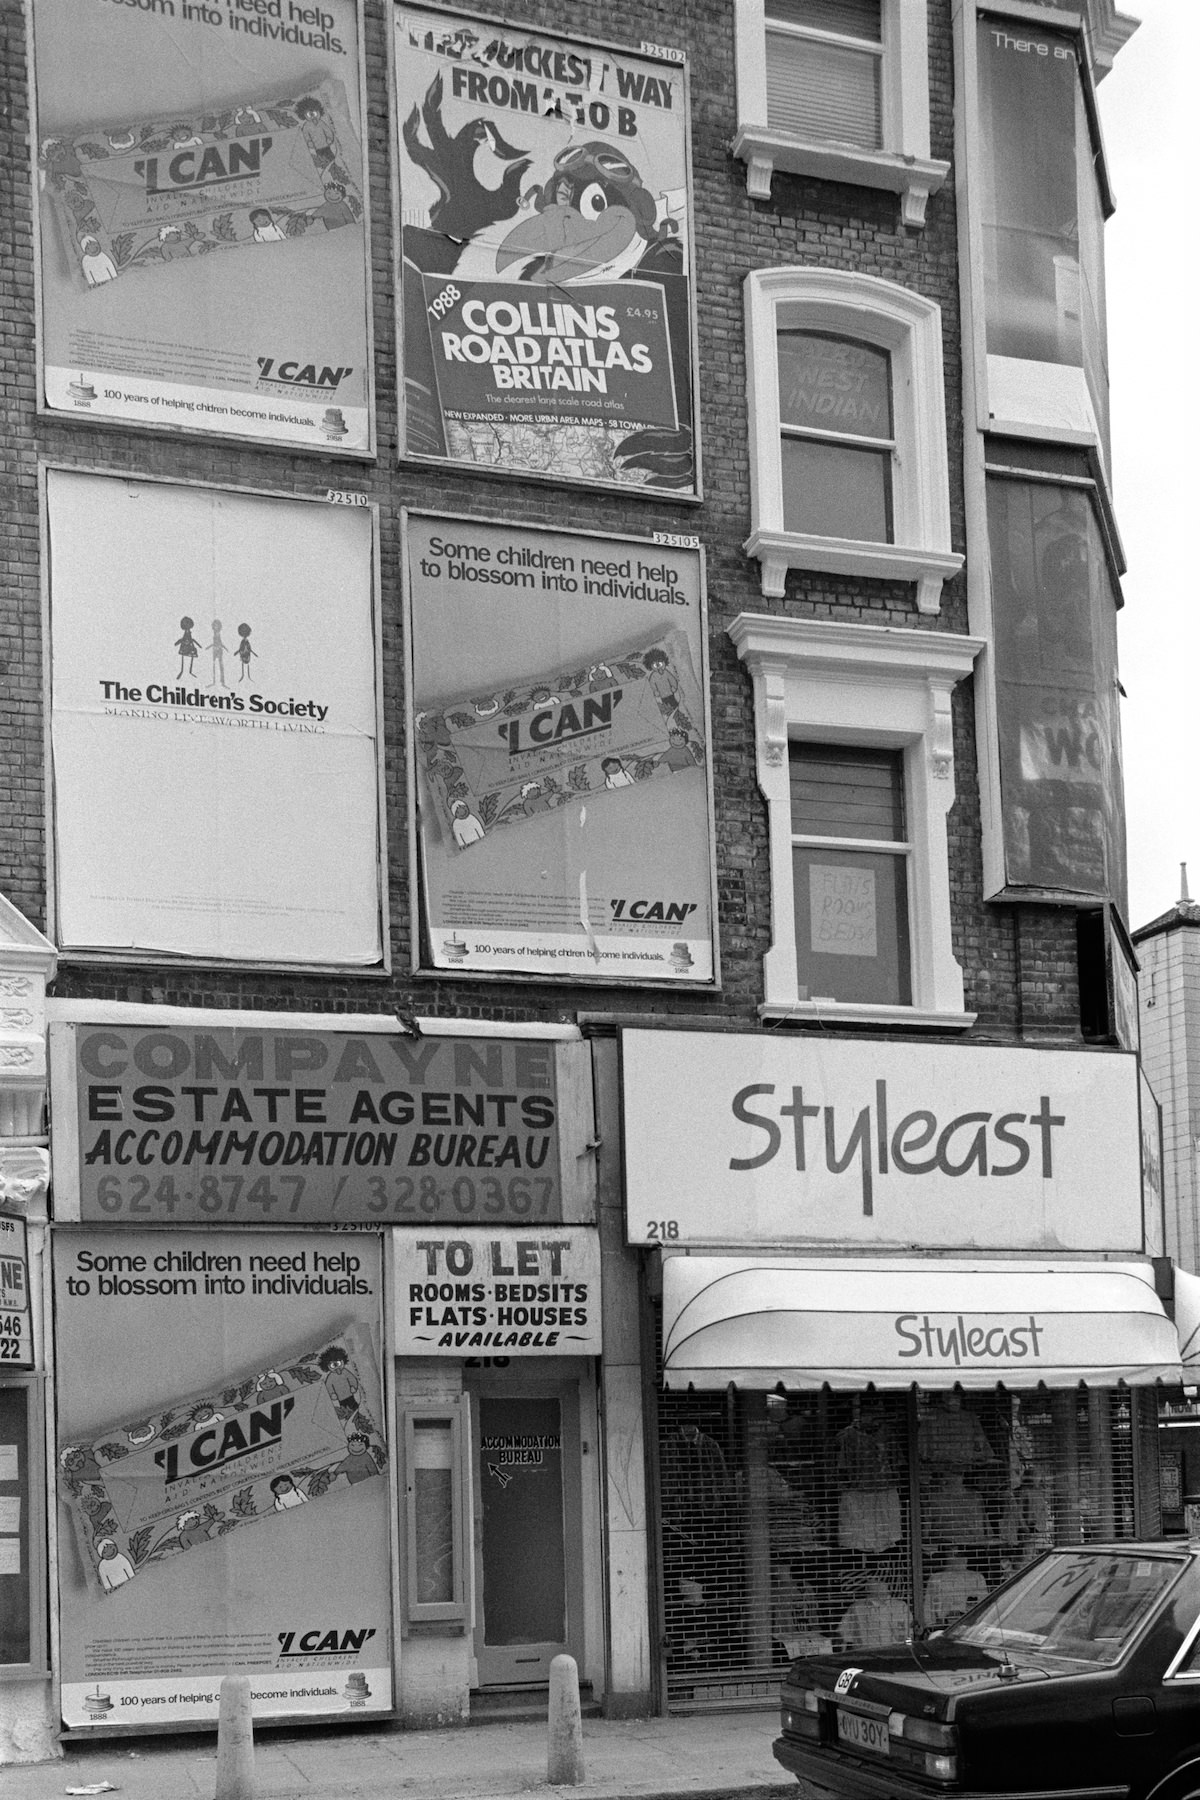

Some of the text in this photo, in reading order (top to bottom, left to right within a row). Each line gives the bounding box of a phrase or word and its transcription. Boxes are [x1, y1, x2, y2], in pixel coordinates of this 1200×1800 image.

[182, 1, 222, 26] into
[229, 10, 347, 55] individuals.
[289, 1, 334, 32] help
[641, 43, 685, 61] 325102
[991, 31, 1048, 56] There
[452, 66, 538, 114] FROM
[618, 105, 638, 137] B
[616, 67, 672, 109] WAY
[427, 283, 462, 321] 1988
[626, 306, 659, 320] £4.95
[461, 300, 620, 341] COLLINS
[441, 331, 652, 374] ROAD ATLAS
[492, 364, 608, 393] BRITAIN
[103, 389, 122, 400] 100
[123, 391, 149, 406] years
[150, 395, 161, 405] of
[161, 397, 194, 412] helping
[230, 406, 266, 420] become
[268, 411, 316, 427] individuals.
[486, 393, 503, 403] The
[504, 394, 537, 404] clearest
[558, 396, 580, 406] scale
[581, 397, 602, 408] road
[603, 399, 625, 410] atlas
[788, 388, 880, 422] INDIAN
[444, 410, 462, 420] NEW
[463, 411, 504, 422] EXPANDED
[510, 414, 534, 423] MORE
[559, 416, 580, 425] AREA
[581, 418, 603, 427] MAPS
[654, 533, 698, 548] 325105
[429, 536, 678, 587] Some children need help
[420, 558, 690, 606] to blossom into individuals.
[100, 681, 328, 722] The Children's Society
[475, 944, 491, 953] 100
[492, 946, 516, 956] years
[516, 947, 526, 955] of
[526, 947, 557, 958] helping
[621, 951, 666, 961] individuals.
[79, 1031, 552, 1089] COMPAYNE
[88, 1084, 555, 1130] ESTATE AGENTS
[85, 1128, 549, 1170] ACCOMMODATION BUREAU
[729, 1078, 1066, 1217] Styleast
[646, 1220, 679, 1241] 218
[77, 1250, 360, 1276] Some children need help
[416, 1240, 571, 1277] TO LET
[66, 1275, 373, 1296] to blossom into individuals.
[438, 1331, 560, 1347] AVAILABLE
[895, 1315, 1043, 1366] Styleast
[480, 1435, 561, 1450] ACCOMMODATION
[499, 1450, 543, 1465] BUREAU
[838, 1672, 853, 1688] GB
[120, 1696, 138, 1706] 100
[140, 1696, 166, 1707] years
[168, 1695, 178, 1704] of
[179, 1693, 214, 1704] helping
[250, 1690, 288, 1700] become
[290, 1686, 338, 1698] individuals.
[89, 1713, 107, 1721] 1888
[861, 1721, 883, 1747] 30Y
